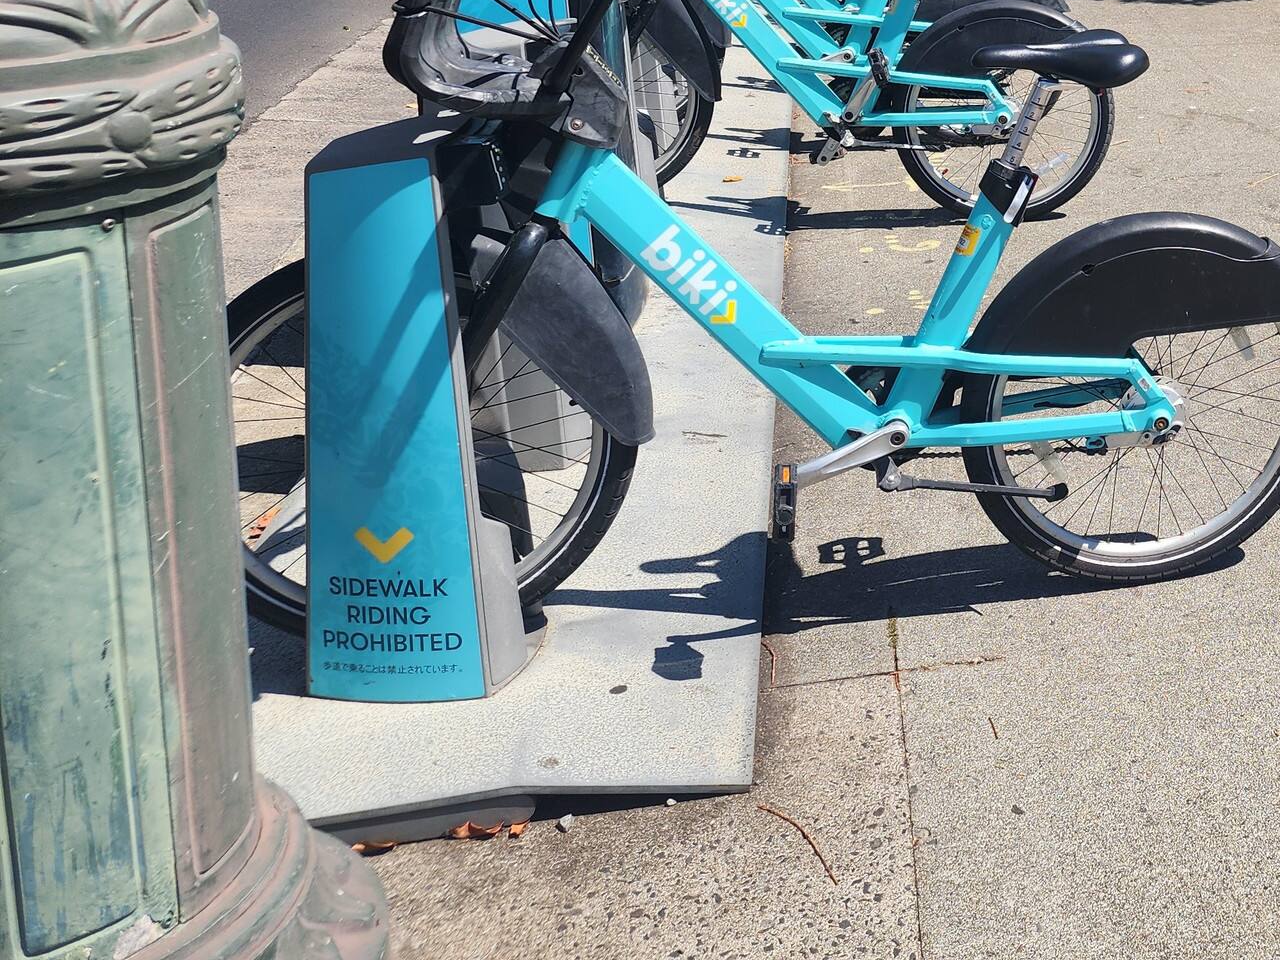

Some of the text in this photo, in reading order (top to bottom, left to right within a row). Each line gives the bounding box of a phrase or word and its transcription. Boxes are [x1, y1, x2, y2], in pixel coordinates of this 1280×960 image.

[640, 223, 737, 316] biki
[329, 576, 448, 598] SIDEWALK
[347, 605, 431, 625] RIDING
[323, 630, 463, 652] PROHIBITED
